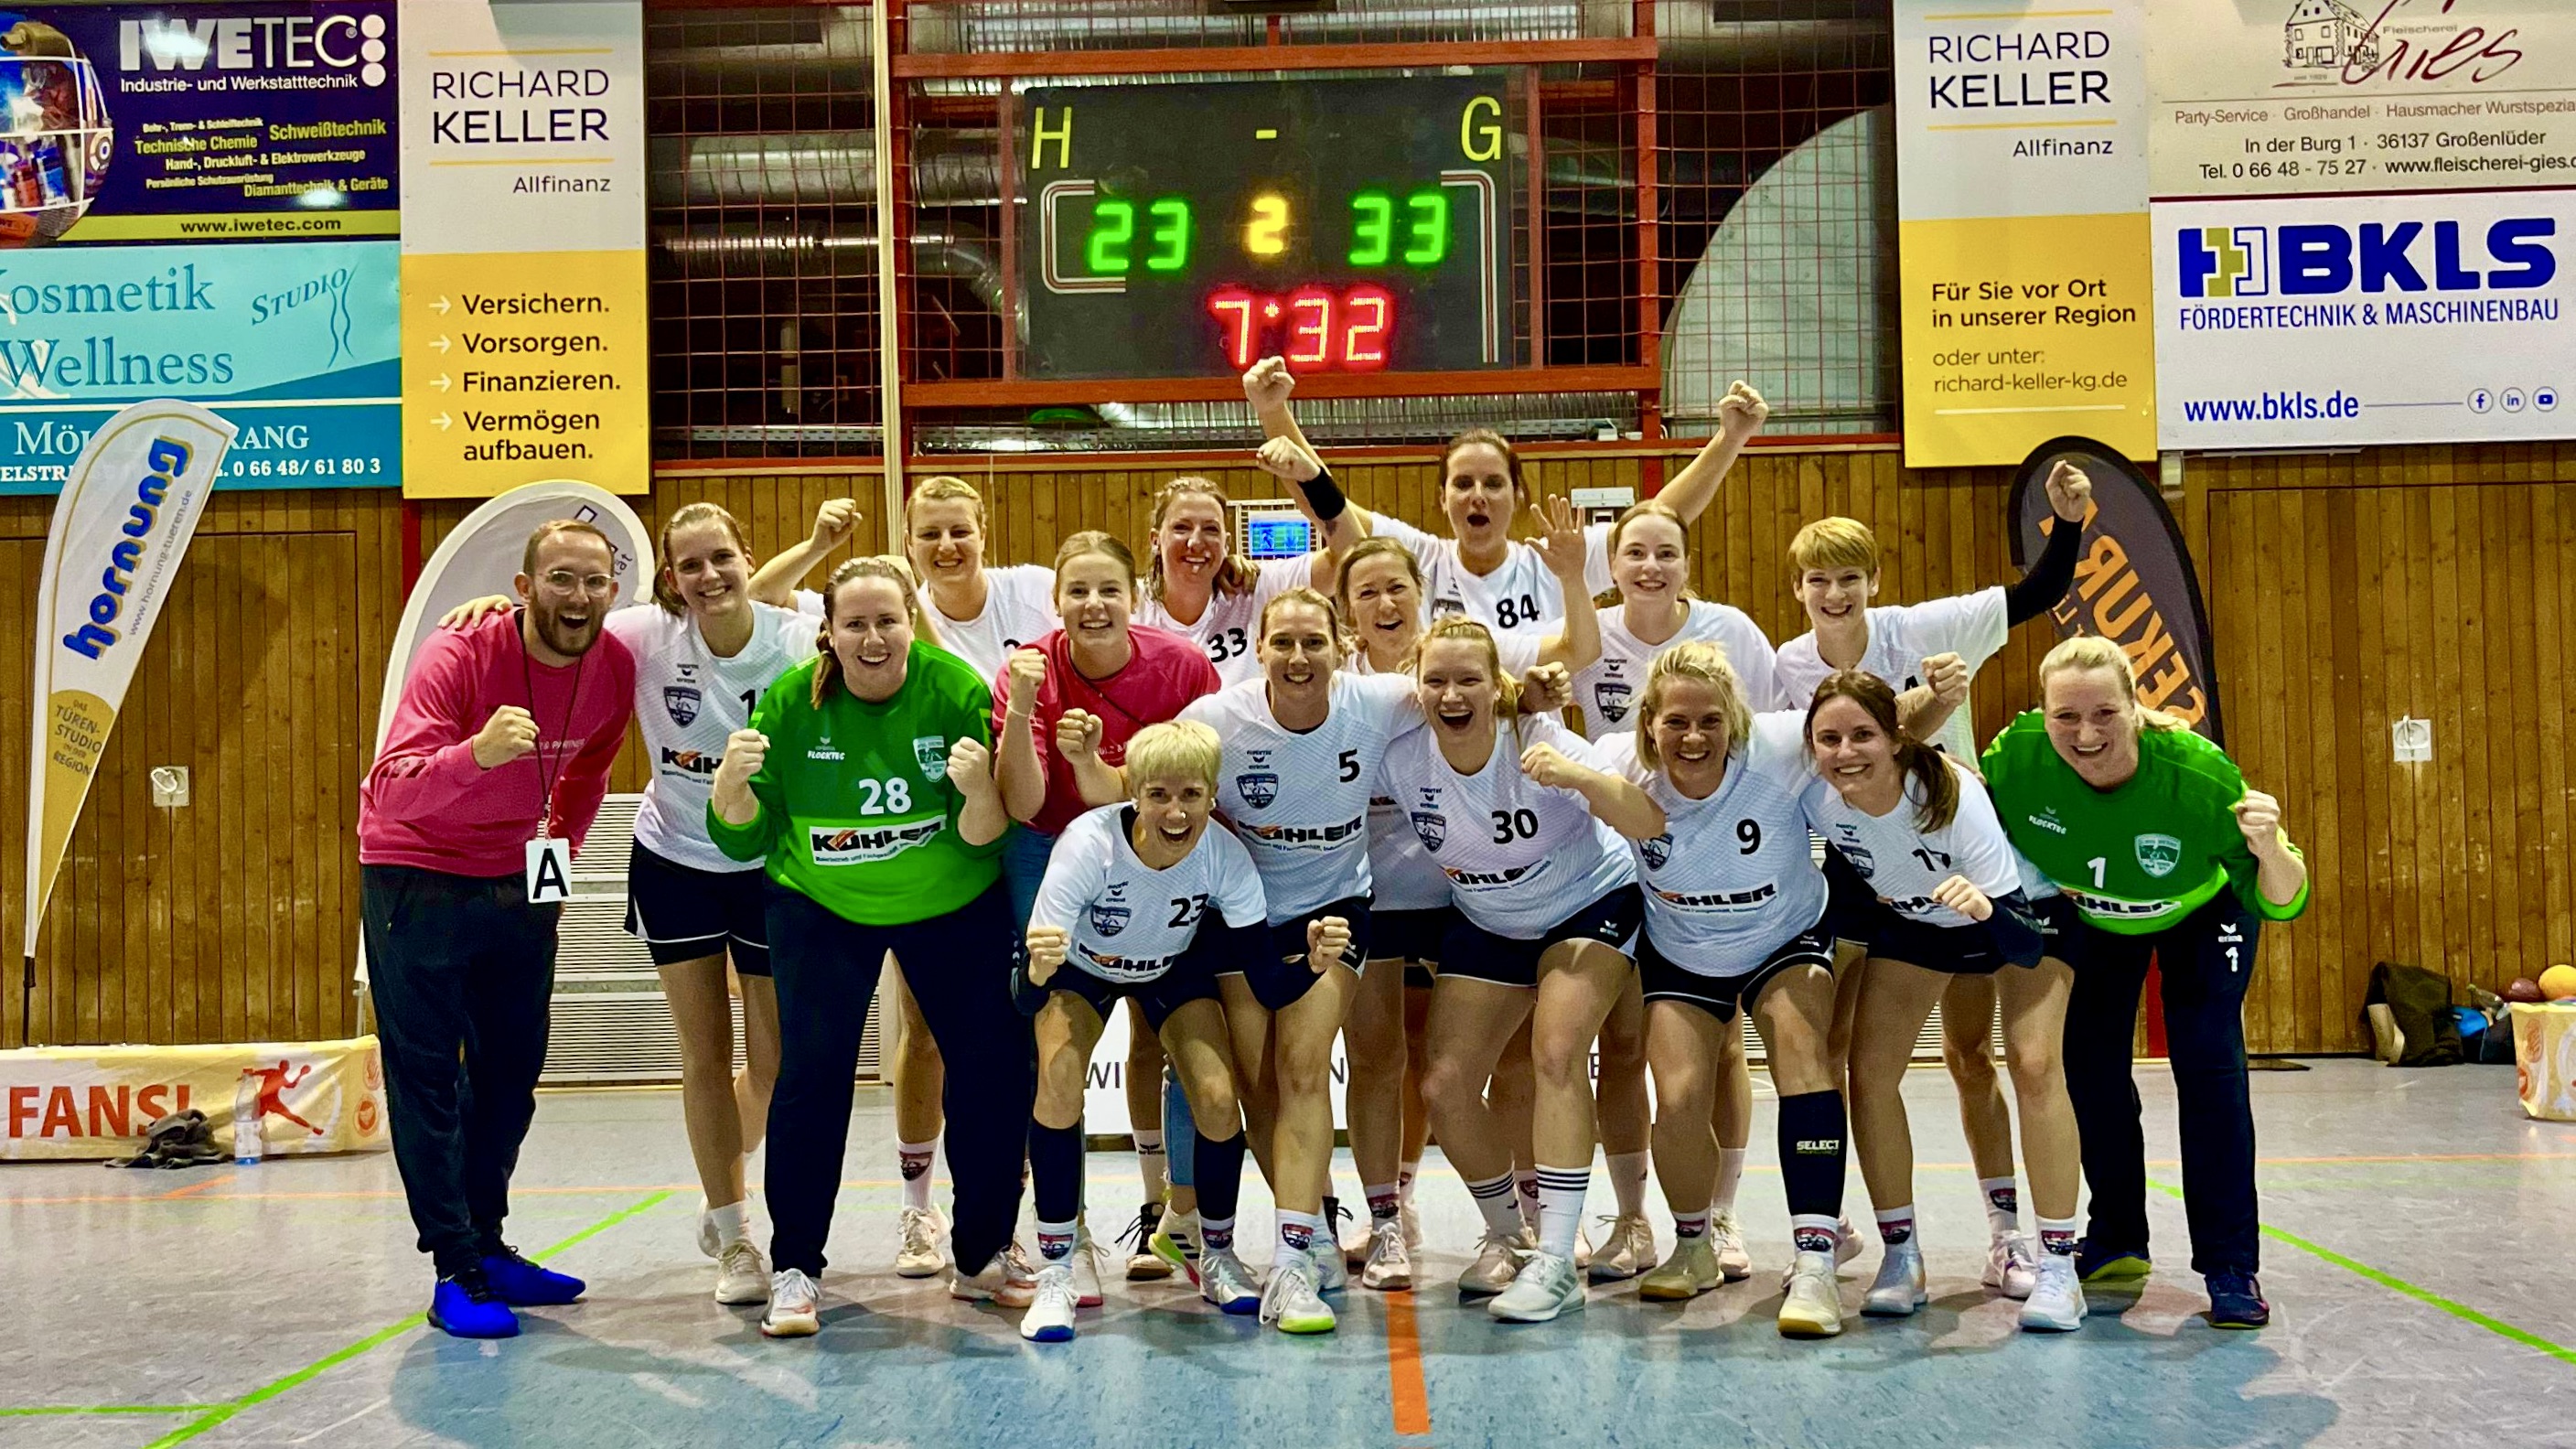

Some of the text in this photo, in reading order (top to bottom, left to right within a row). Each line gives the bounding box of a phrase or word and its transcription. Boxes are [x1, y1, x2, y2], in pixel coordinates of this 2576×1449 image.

[119, 14, 358, 71] IWETEC
[2383, 24, 2458, 36] Fleischerei
[1929, 31, 2110, 63] RICHARD
[120, 73, 358, 92] Industrie- und Werkstatttechnik
[433, 69, 609, 99] RICHARD
[1930, 70, 2111, 109] KELLER
[433, 108, 609, 144] KELLER
[1461, 96, 1502, 161] G
[2175, 110, 2269, 126] Party-Service
[2284, 105, 2371, 121] Großhandel
[2386, 102, 2482, 119] Hausmacher
[134, 134, 258, 155] Technische Chemie
[269, 119, 386, 141] Schweißtechnik
[1031, 106, 1072, 169] H
[2245, 130, 2547, 156] In der Burg 1 36137 Großenlüder
[166, 149, 366, 171] Hand-, Druckluft- & Elektrowerkzeuge
[2012, 139, 2113, 157] Allfinanz
[2199, 164, 2228, 179] Tel.
[2232, 163, 2244, 178] 0
[2249, 162, 2272, 177] 66
[2277, 161, 2300, 177] 48
[2317, 160, 2339, 176] 75
[2345, 158, 2367, 175] 27
[243, 177, 389, 198] Diamanttechnik & Geräte
[512, 175, 611, 194] Allfinanz
[180, 218, 341, 233] www.iwetec.com
[1088, 200, 1188, 272] 23
[1247, 194, 1288, 255] 2
[1348, 194, 1446, 265] 33
[2278, 217, 2557, 295] BKLS
[462, 293, 610, 315] Versichern.
[1932, 279, 2107, 301] Für Sie vor Ort
[1932, 305, 2136, 327] in unserer Region
[2180, 298, 2560, 330] FÖRDERTECHNIK & MASCHINENBAU
[462, 333, 608, 356] Vorsorgen.
[1932, 347, 2045, 366] oder unter:
[0, 337, 233, 388] Wellness
[463, 370, 621, 392] Finanzieren.
[1934, 370, 2128, 392] richard-keller-kg.de
[2184, 390, 2360, 422] www.bkls.de
[463, 410, 600, 434] Vermögen
[463, 440, 594, 460] aufbauen.
[233, 461, 245, 477] 0
[249, 460, 272, 476] 66
[277, 458, 307, 476] 48/
[315, 459, 335, 475] 61
[342, 458, 365, 474] 80
[370, 458, 381, 473] 3
[63, 437, 194, 660] hornung
[128, 488, 193, 637] www.hornung-tueren.de
[1496, 595, 1540, 629] 84
[1208, 628, 1248, 663] 33
[56, 705, 101, 735] TÜREN-
[55, 724, 102, 753] STUDIO
[1338, 748, 1360, 782] 5
[858, 777, 912, 815] 28
[1491, 809, 1539, 844] 30
[1736, 819, 1761, 855] 9
[532, 847, 569, 899] A
[2087, 856, 2107, 889] 1
[1168, 894, 1208, 928] 23
[2226, 946, 2238, 972] 1
[9, 1085, 190, 1137] FANS!
[1797, 1140, 1839, 1150] SELECT
